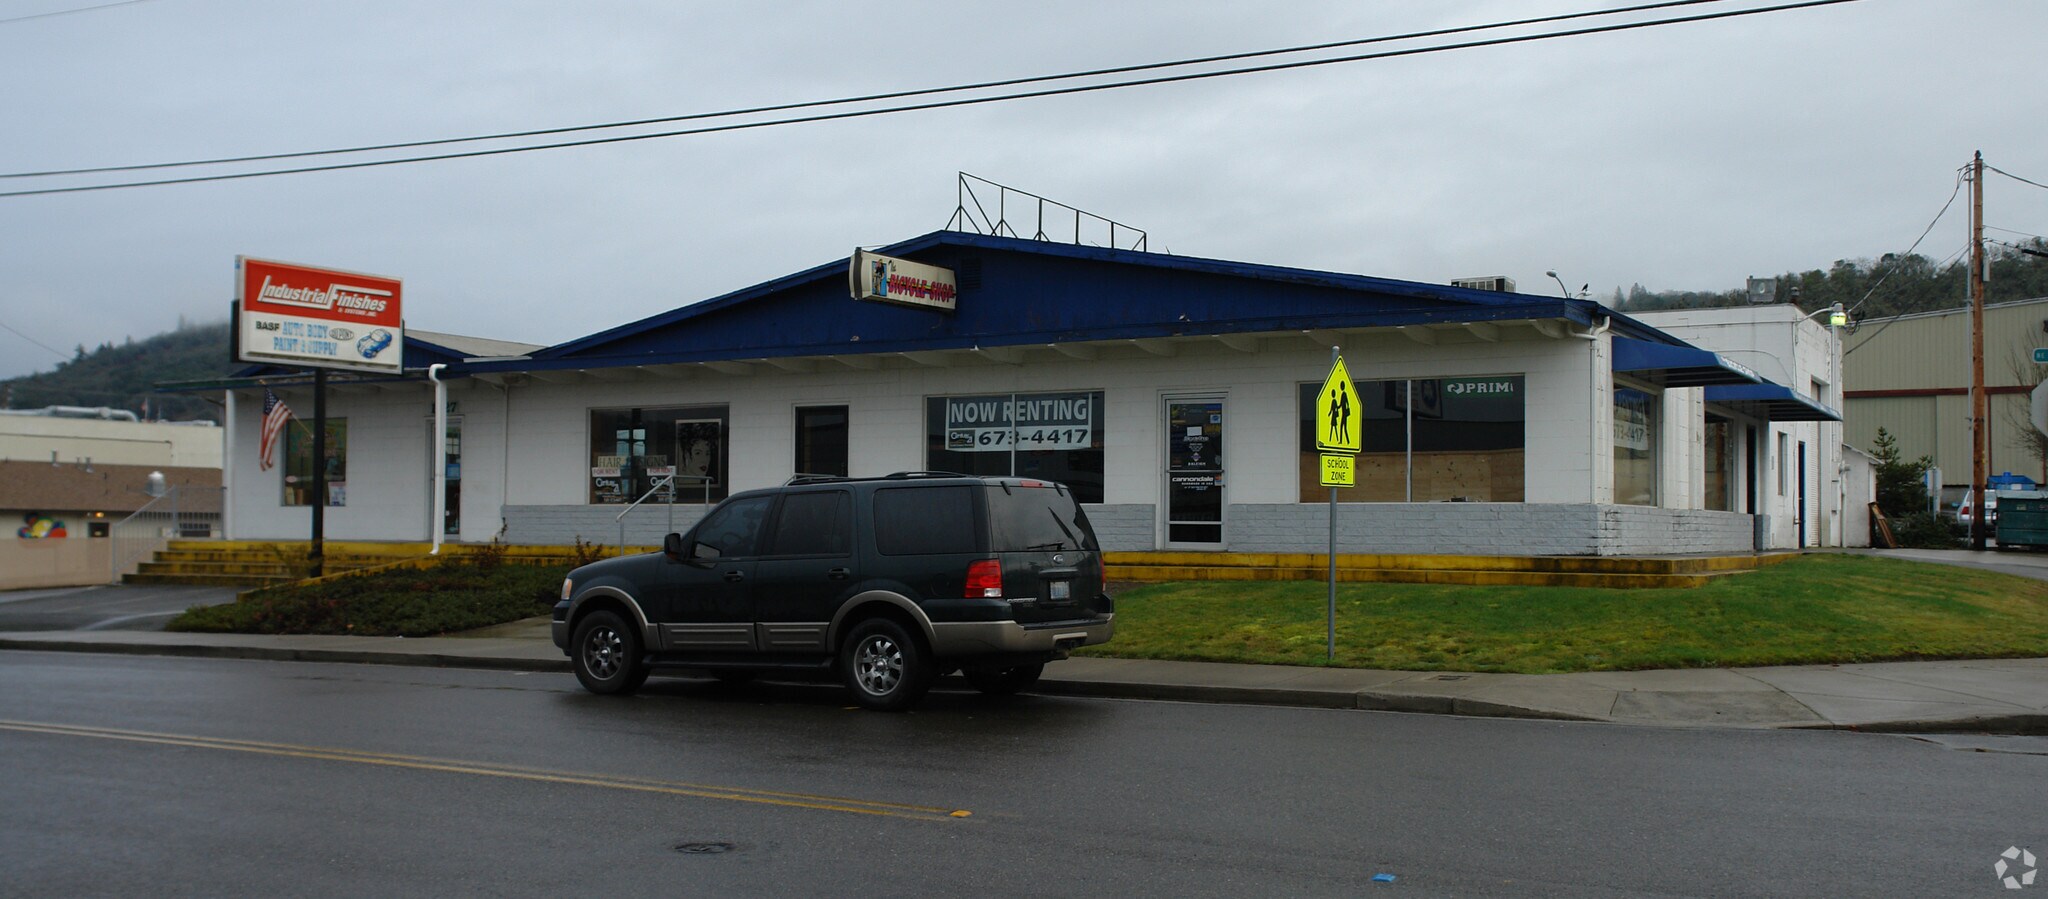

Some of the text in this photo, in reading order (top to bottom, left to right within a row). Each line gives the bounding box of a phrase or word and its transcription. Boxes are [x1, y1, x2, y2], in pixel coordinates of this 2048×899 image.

[257, 275, 393, 312] Industrial Finishes
[888, 274, 954, 302] BICYCLE SHOP
[256, 321, 281, 331] BASF
[282, 321, 329, 339] AUTO BODY
[273, 337, 298, 352] PAINT
[308, 341, 338, 356] SUPPLY
[1466, 382, 1514, 393] PRIM
[951, 399, 1087, 423] NOW RENTING
[978, 429, 1088, 446] 673-4417
[599, 457, 621, 468] HAIR
[1327, 458, 1349, 470] SCHOOL
[1331, 471, 1346, 481] ZONE
